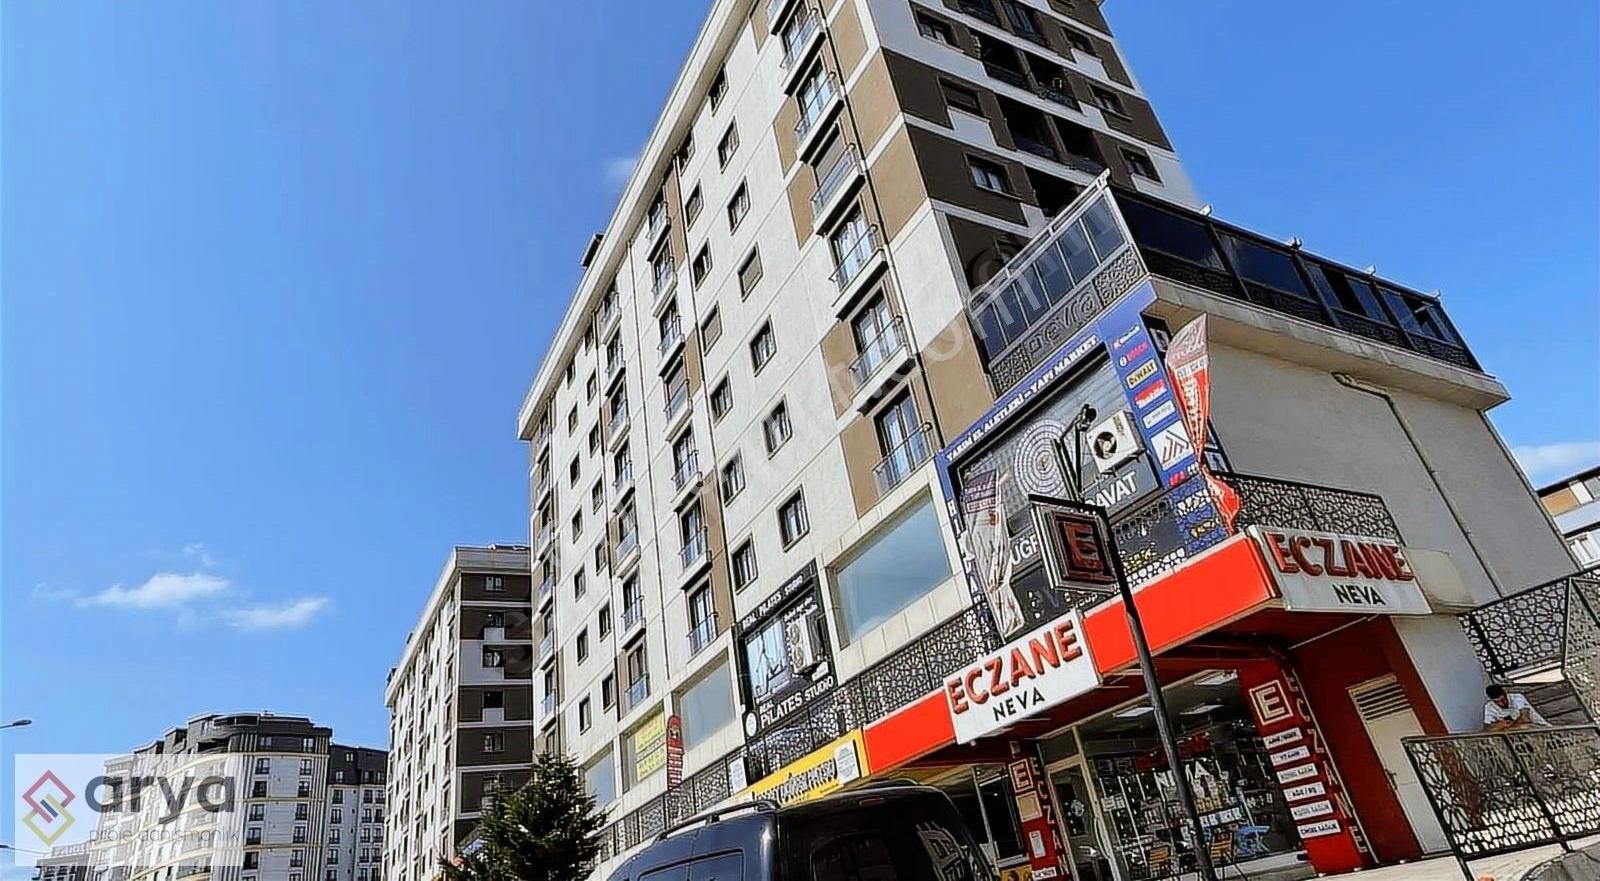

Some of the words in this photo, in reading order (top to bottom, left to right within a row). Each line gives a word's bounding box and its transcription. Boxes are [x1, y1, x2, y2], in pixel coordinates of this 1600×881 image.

[1053, 334, 1098, 374] MARKET
[1064, 521, 1104, 568] E
[1264, 532, 1415, 582] ECZANE
[1332, 584, 1386, 606] NEVA
[946, 619, 1083, 715] ECZANE
[992, 687, 1046, 722] NEVA
[1256, 686, 1286, 720] E
[1013, 763, 1029, 788] E
